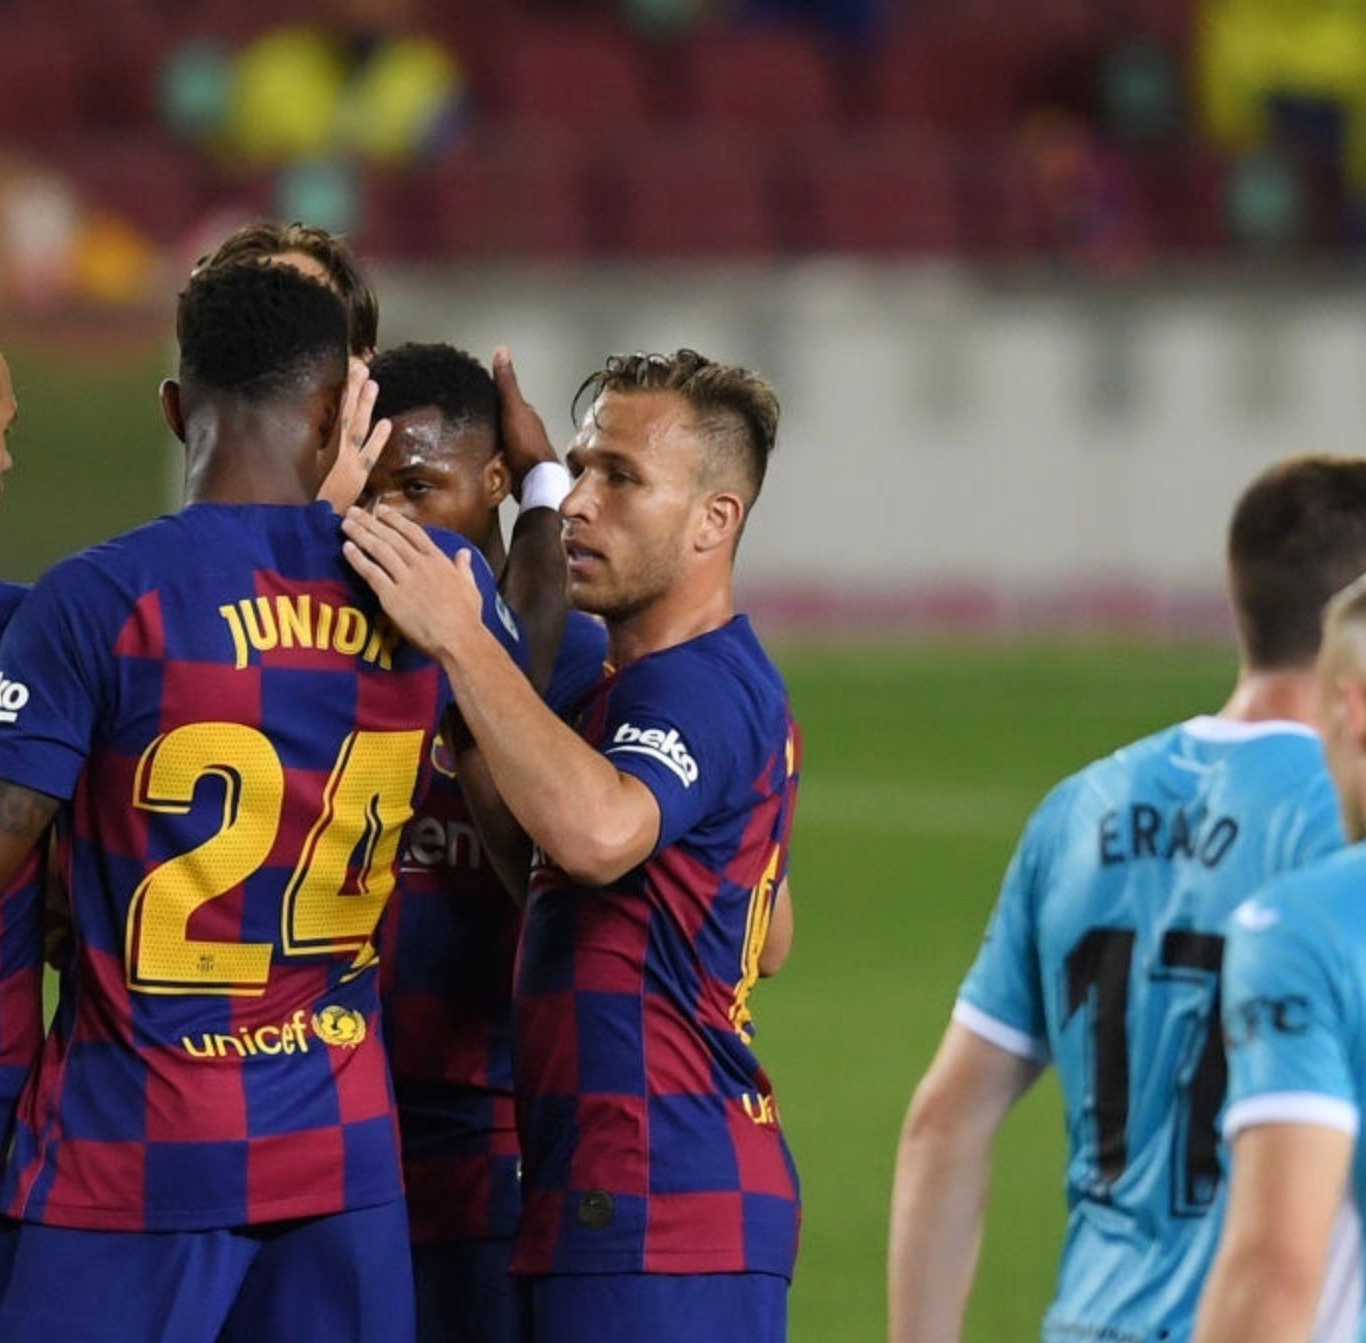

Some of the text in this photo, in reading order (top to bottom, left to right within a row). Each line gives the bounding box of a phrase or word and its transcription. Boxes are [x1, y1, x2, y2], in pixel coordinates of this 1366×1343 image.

[611, 722, 700, 788] beko
[128, 722, 425, 997] 24
[1098, 802, 1240, 869] ERAO
[182, 1010, 310, 1058] unicef
[1060, 927, 1226, 1219] 17
